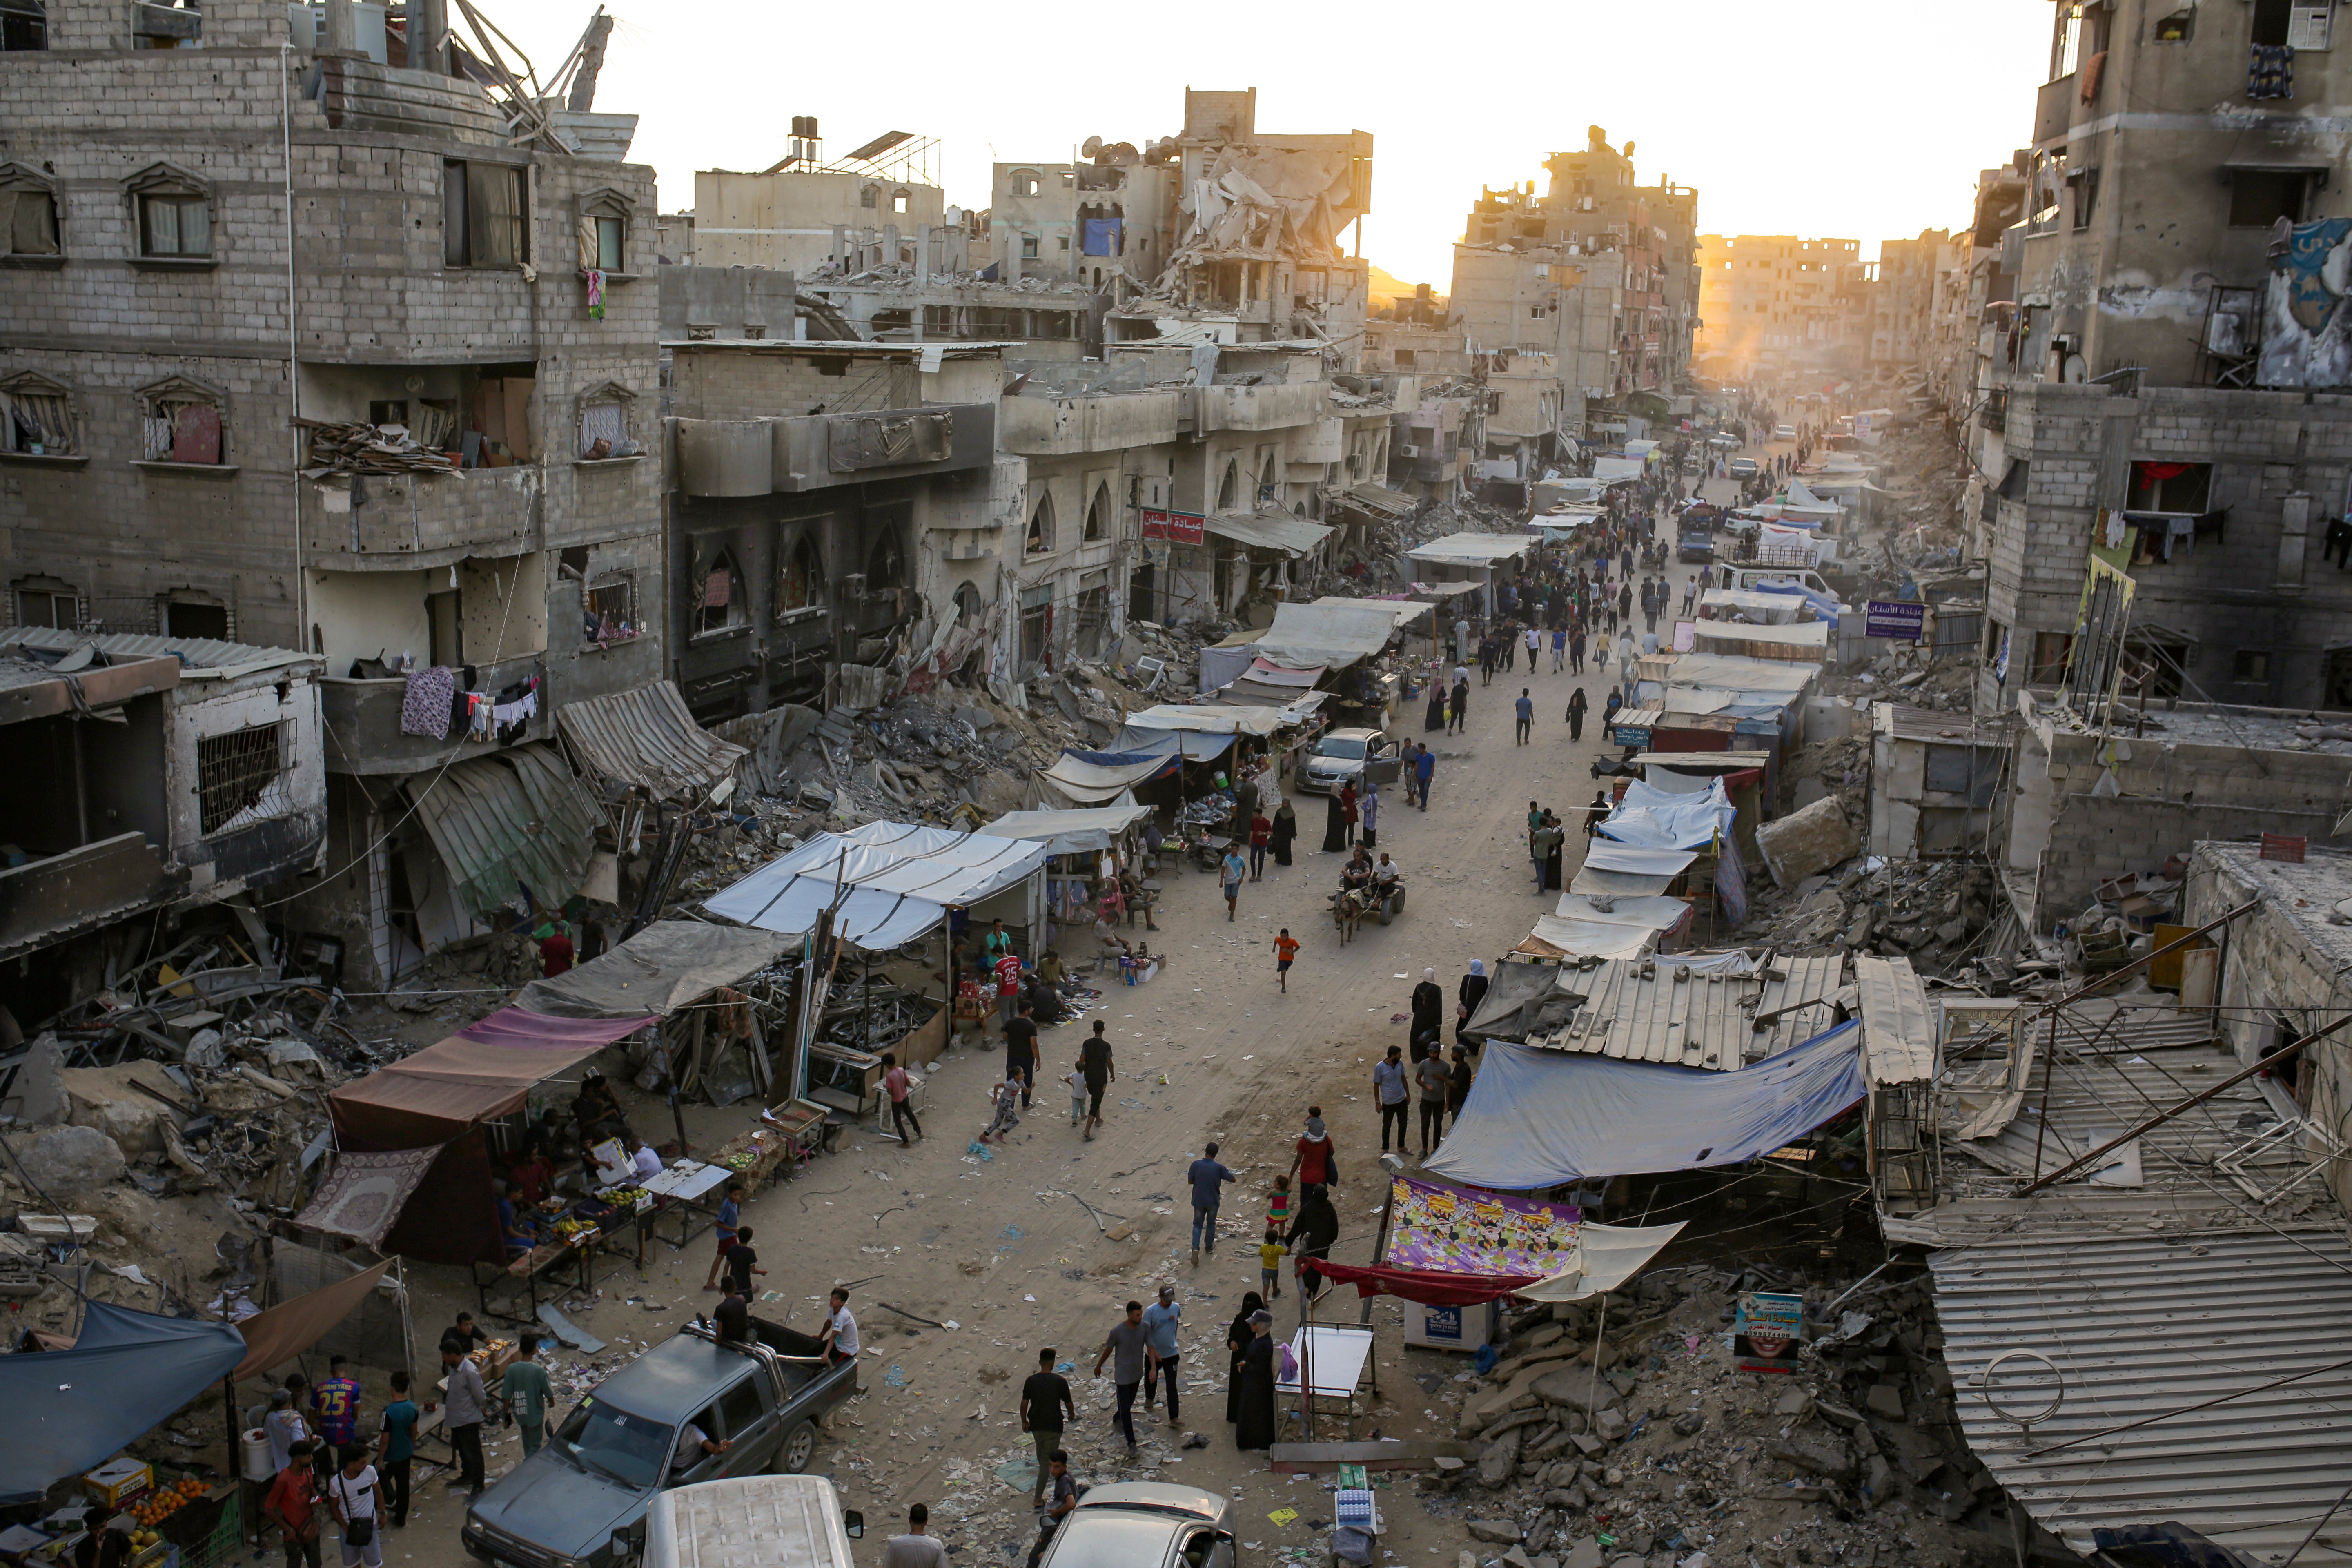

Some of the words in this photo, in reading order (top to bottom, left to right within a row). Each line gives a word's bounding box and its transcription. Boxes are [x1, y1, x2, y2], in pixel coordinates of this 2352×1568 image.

[1174, 517, 1202, 532] عيادة
[1869, 604, 1897, 614] الأسنان
[1900, 607, 1922, 617] عيادة
[1005, 966, 1017, 981] 25
[1773, 1313, 1798, 1326] عيادة
[320, 1391, 346, 1416] 25
